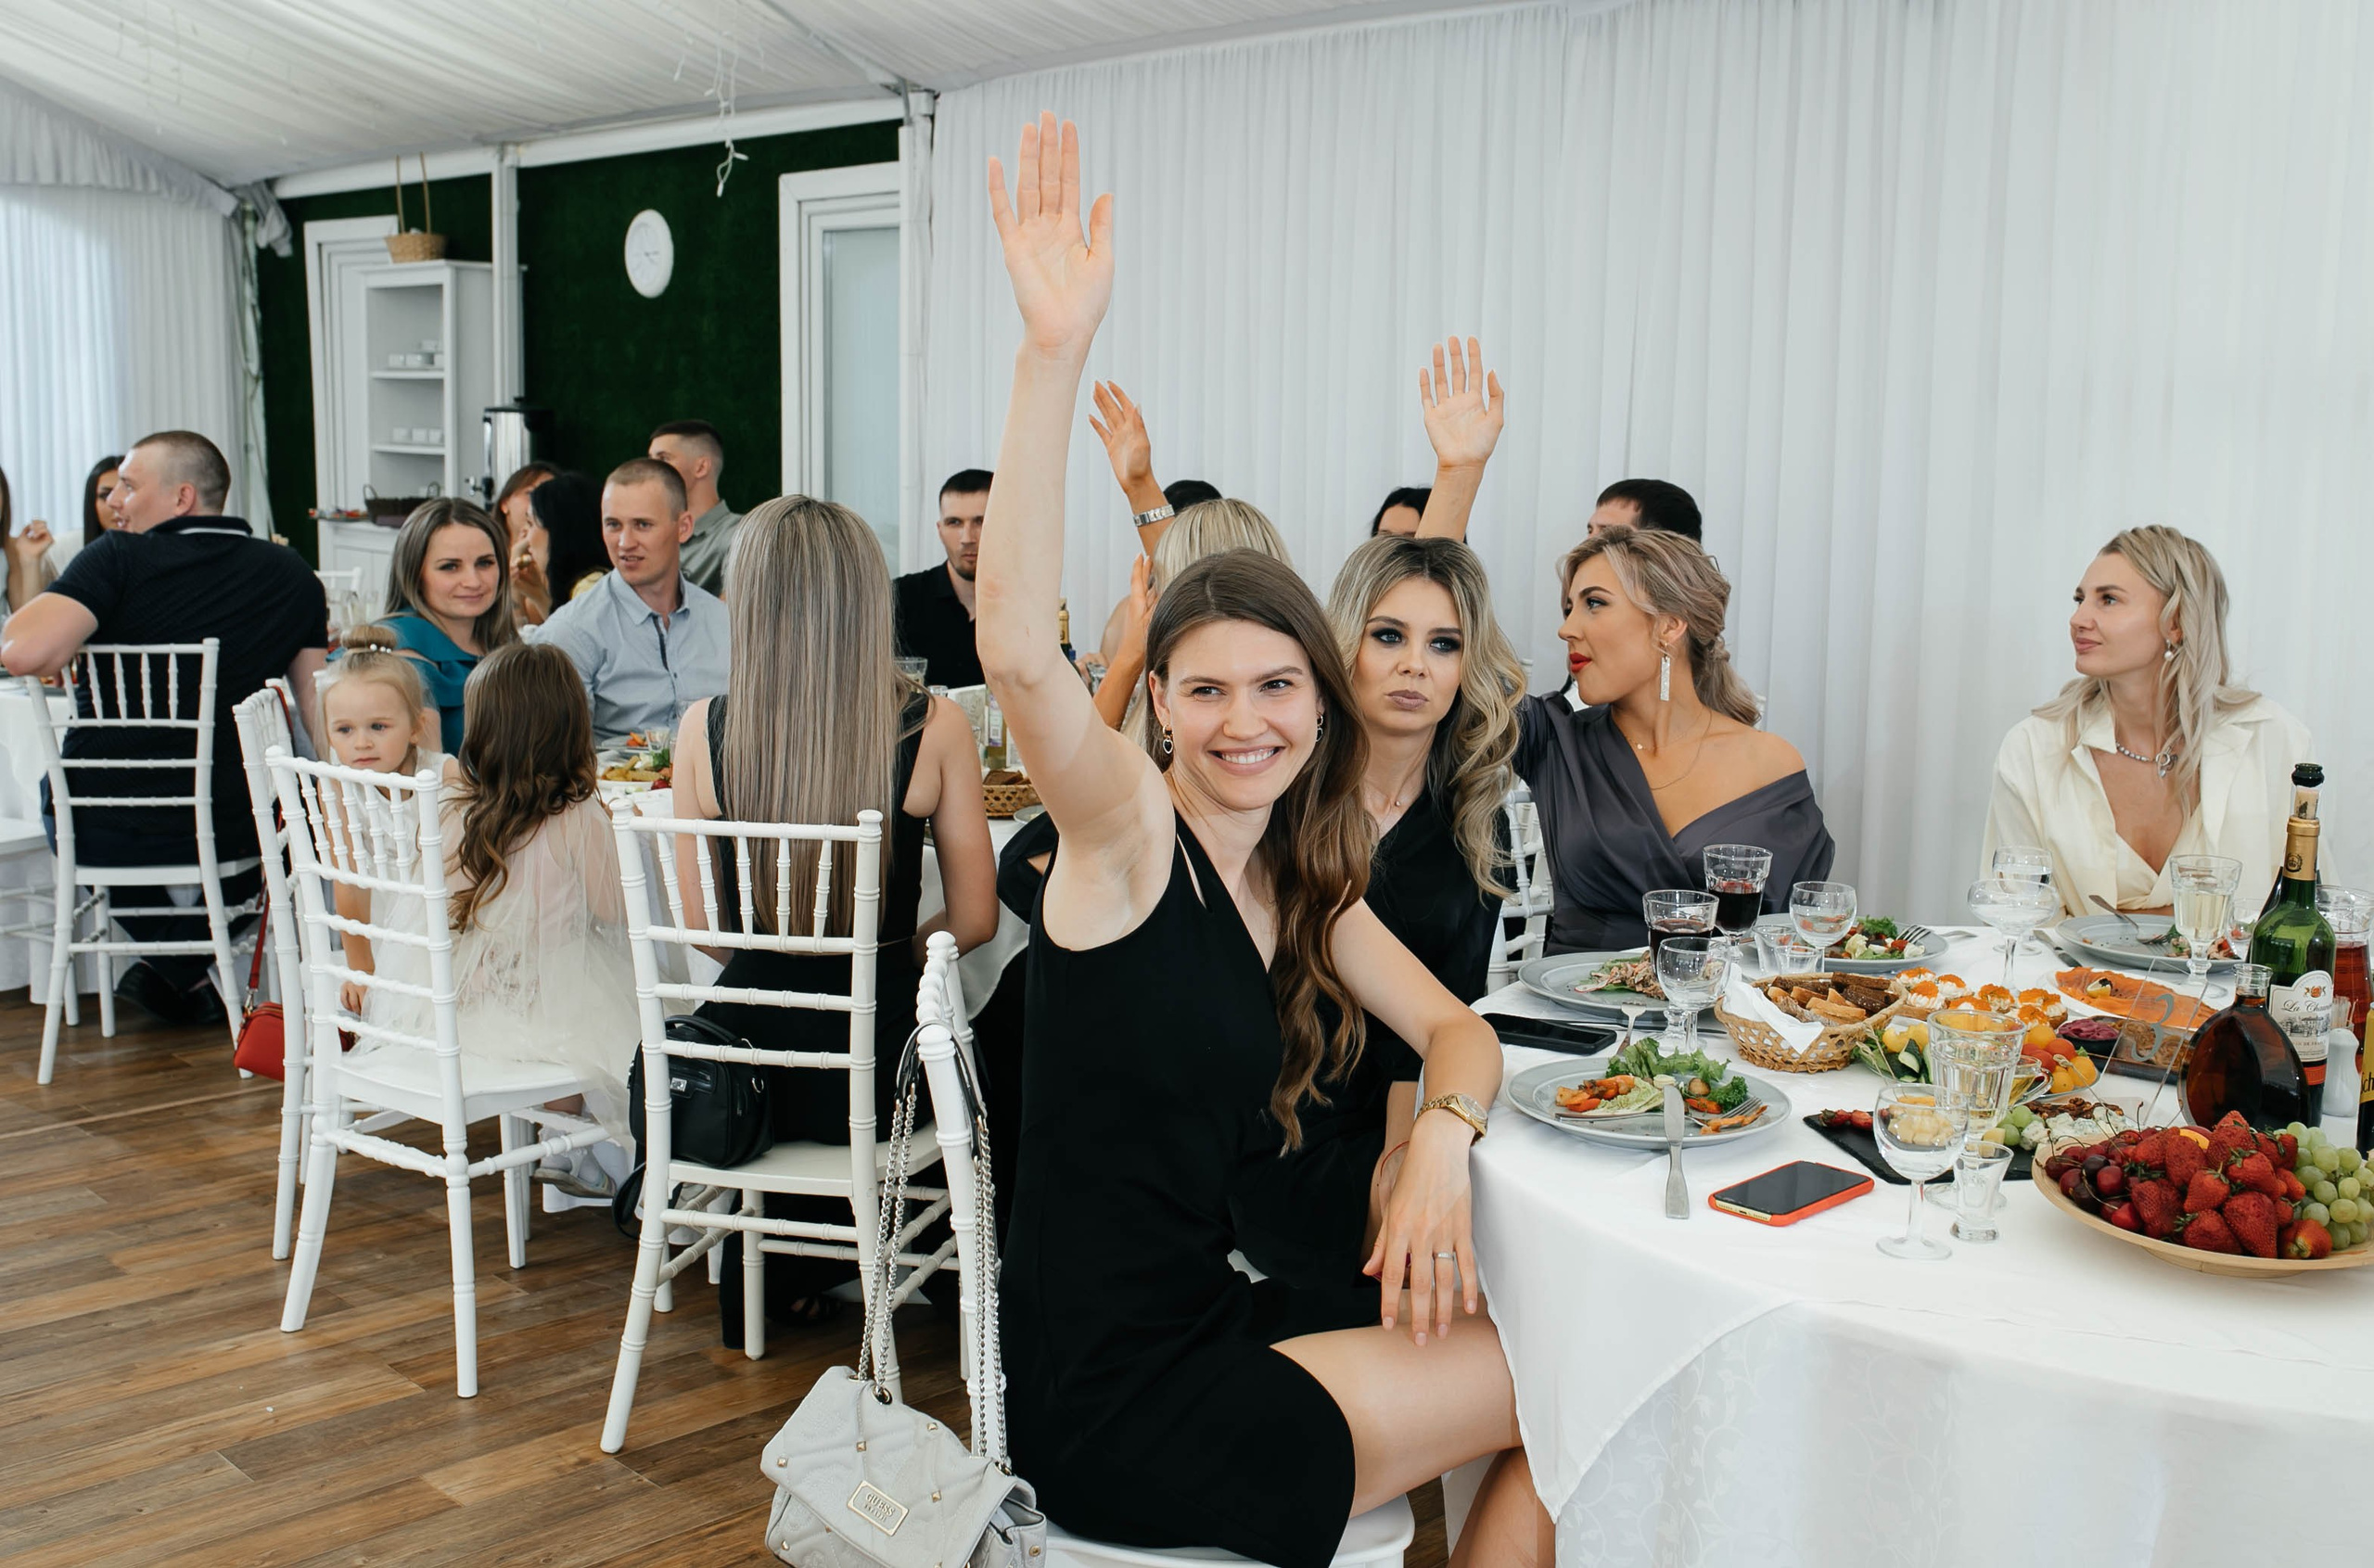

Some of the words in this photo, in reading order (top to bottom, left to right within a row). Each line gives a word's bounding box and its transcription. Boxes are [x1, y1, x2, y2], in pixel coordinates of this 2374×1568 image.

[2280, 999, 2301, 1013] La
[2131, 993, 2174, 1062] 3
[865, 1492, 896, 1517] GUESS
